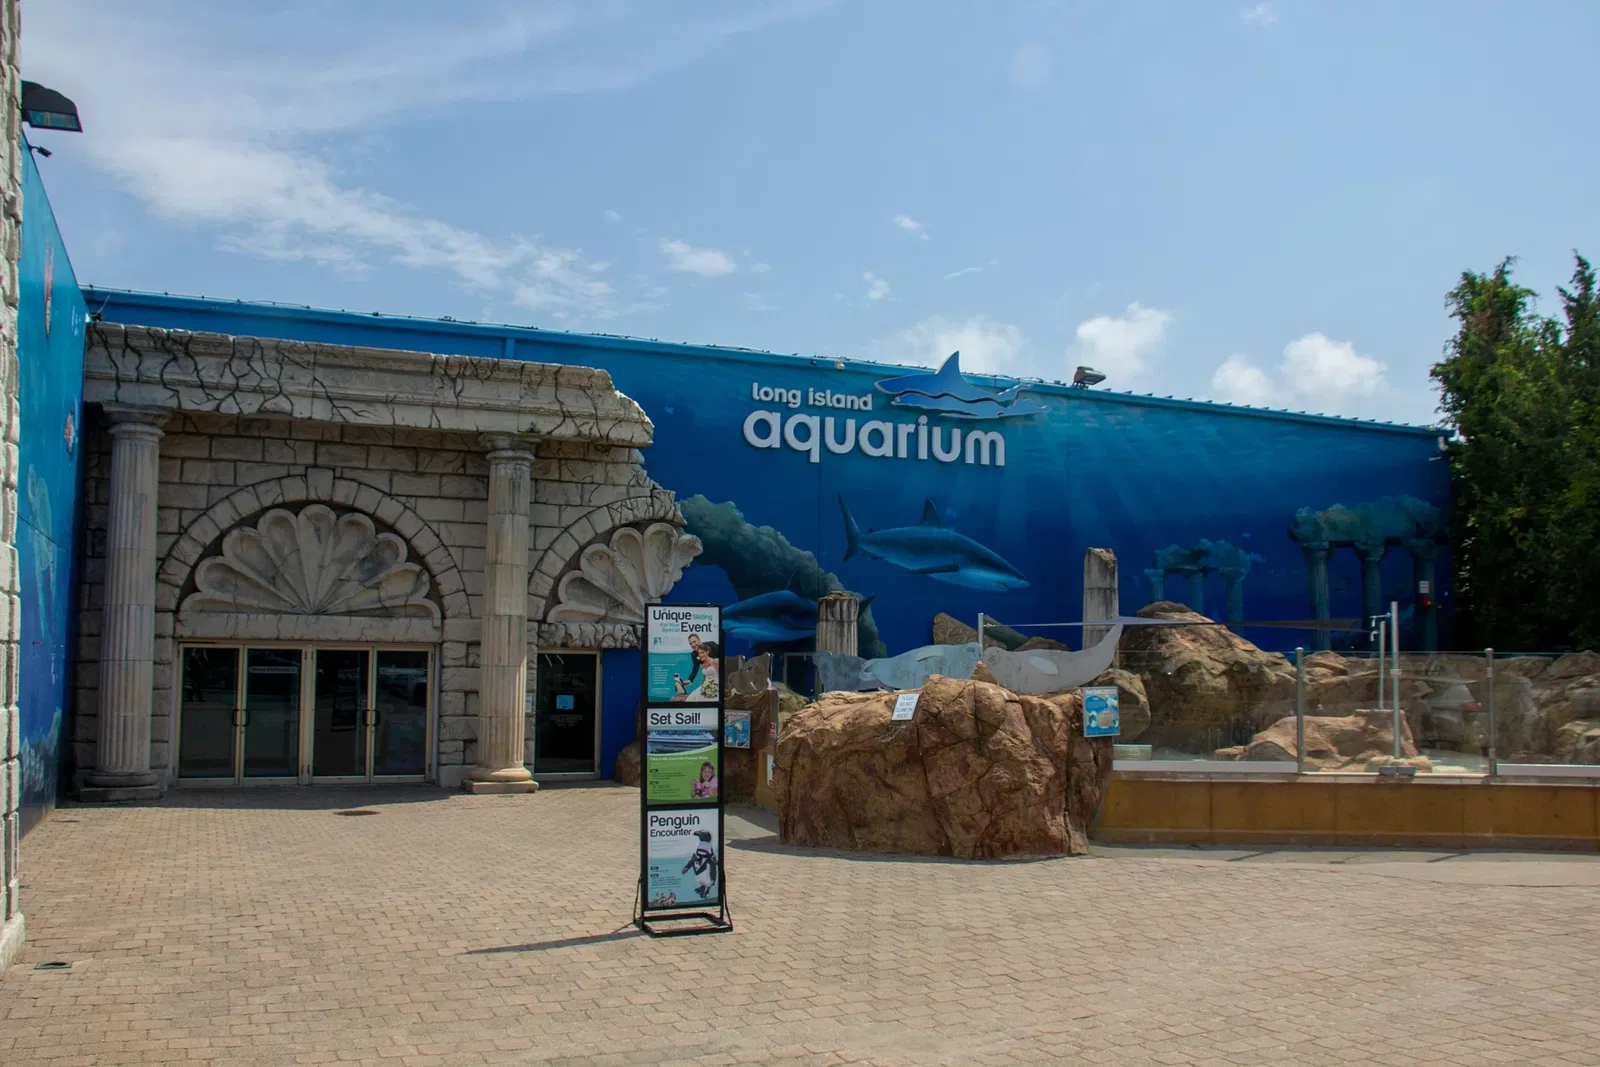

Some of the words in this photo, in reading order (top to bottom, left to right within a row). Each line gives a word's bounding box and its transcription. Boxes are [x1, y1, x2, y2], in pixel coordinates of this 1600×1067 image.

[752, 382, 801, 408] long
[808, 387, 873, 411] island
[743, 410, 1006, 467] aquarium
[653, 609, 691, 623] Unique
[681, 622, 712, 632] Event
[650, 712, 672, 725] Set
[675, 712, 701, 725] Sail!
[650, 814, 700, 829] Penguin
[650, 829, 692, 837] Encounter
